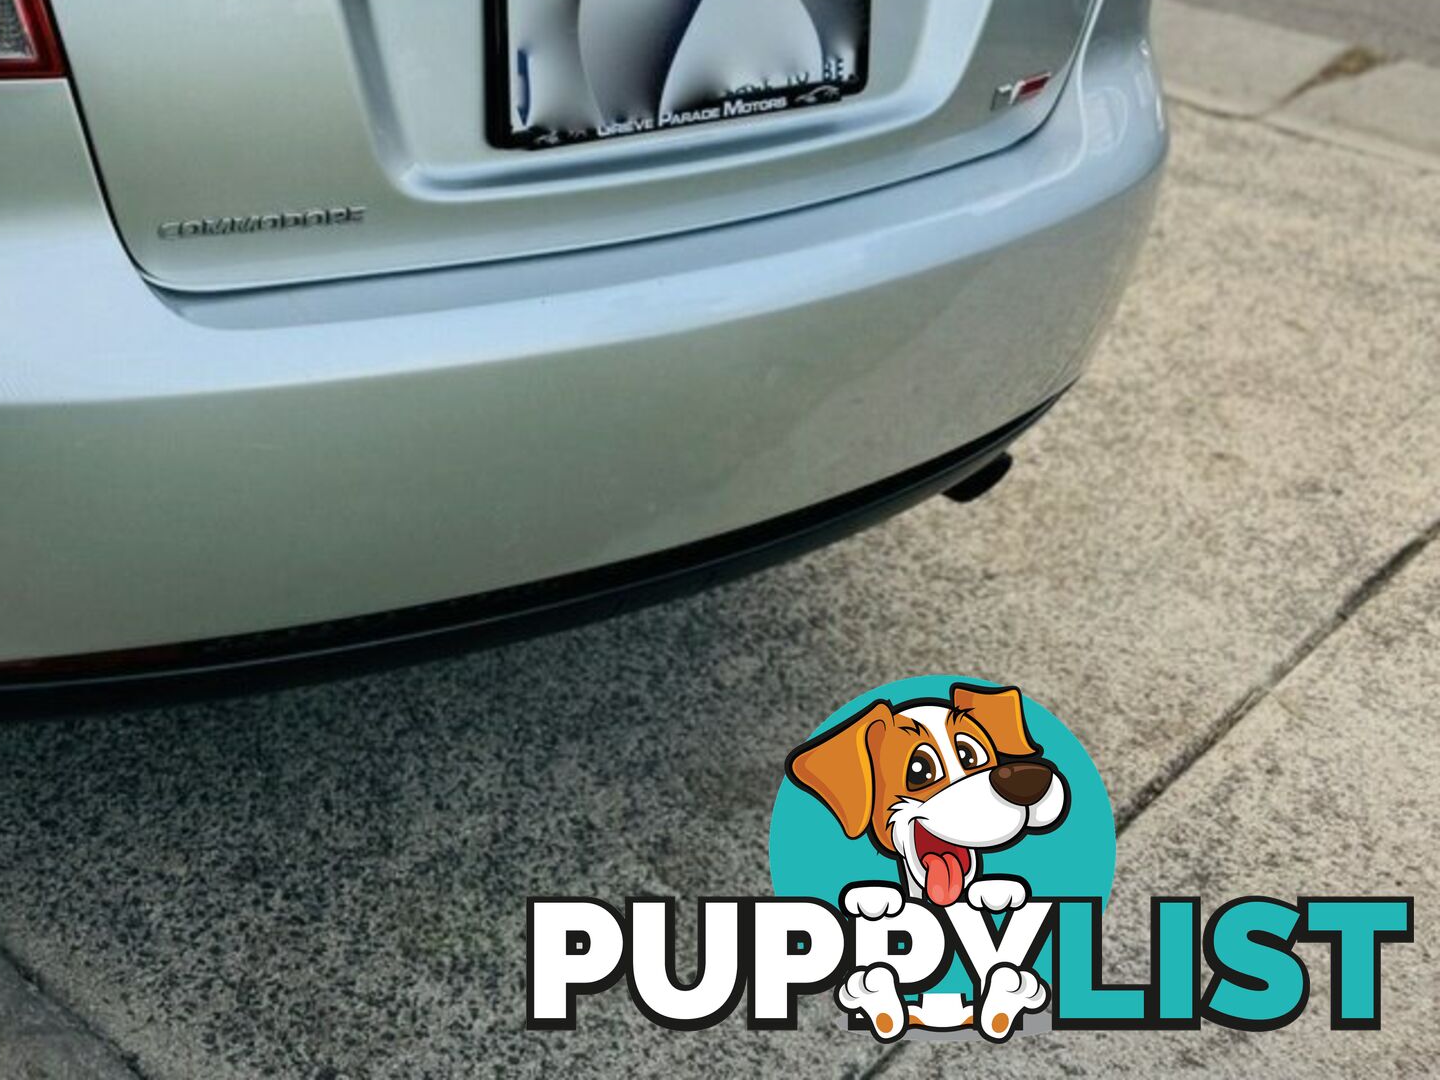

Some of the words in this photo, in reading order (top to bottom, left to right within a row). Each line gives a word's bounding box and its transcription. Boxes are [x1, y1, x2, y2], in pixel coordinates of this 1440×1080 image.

[658, 105, 720, 127] PARADE
[723, 97, 787, 117] MOTORS
[157, 205, 366, 240] COMMODORE
